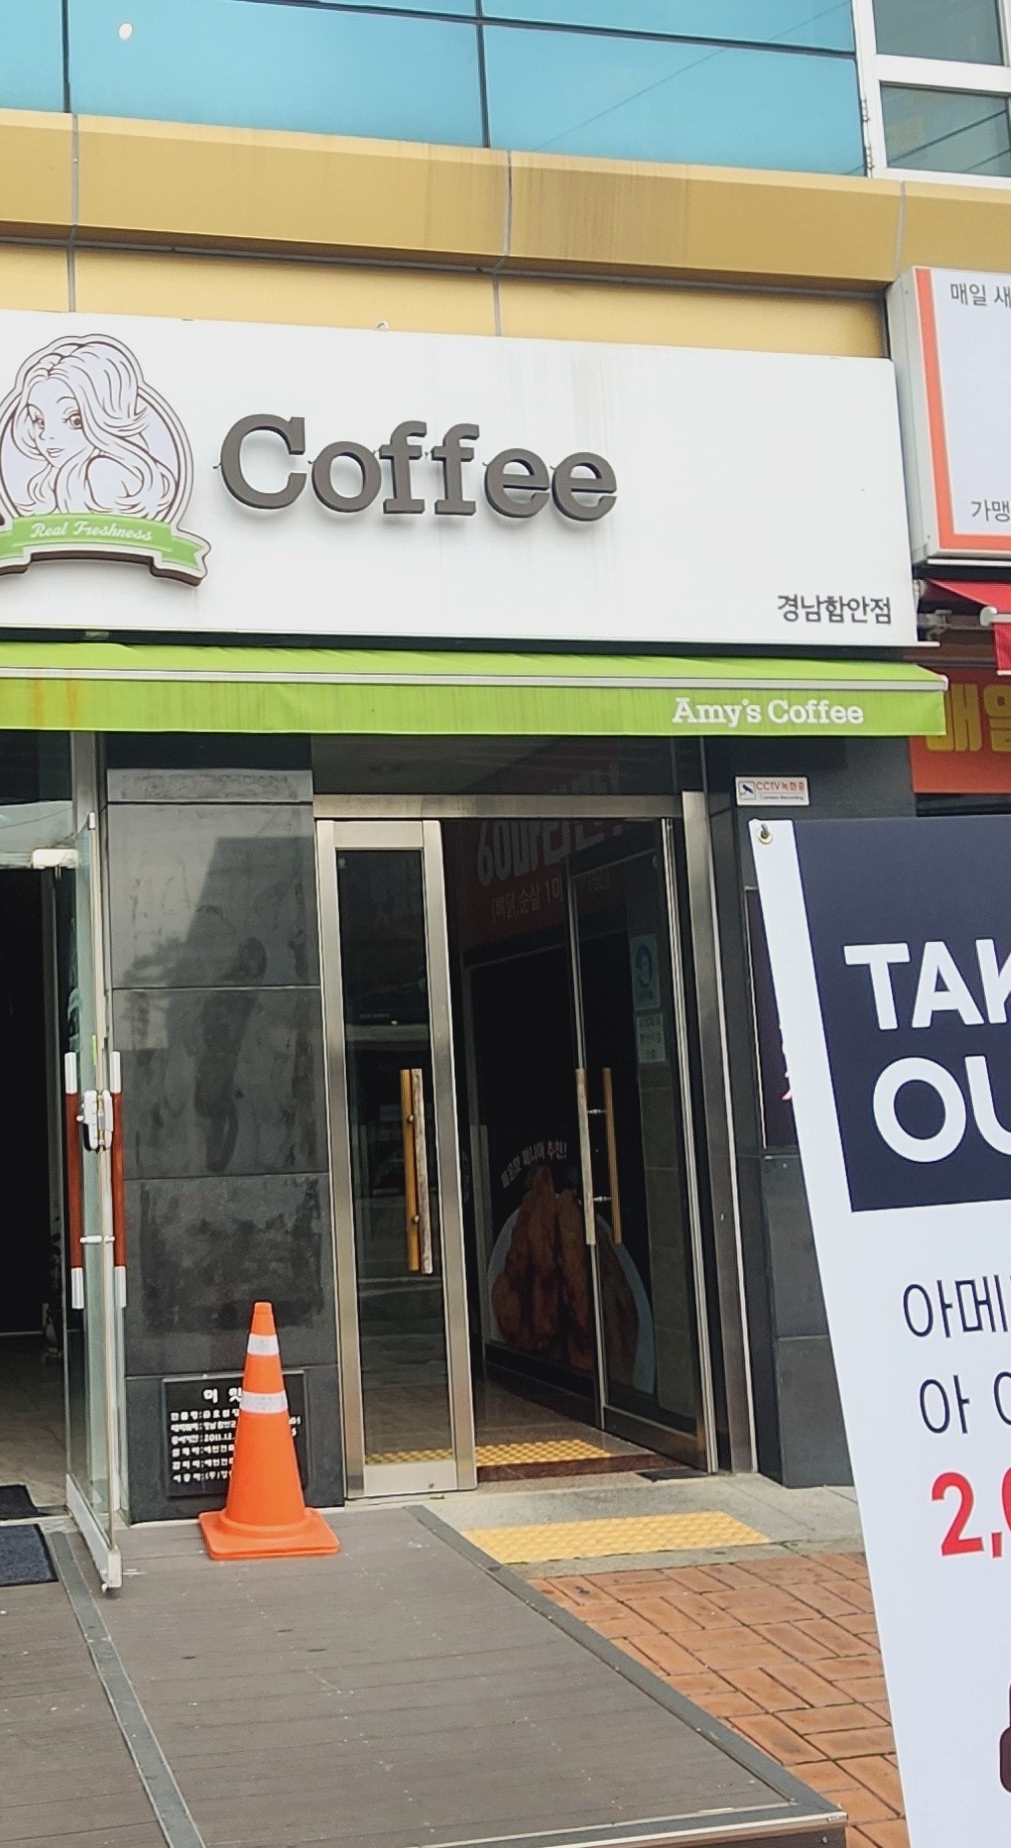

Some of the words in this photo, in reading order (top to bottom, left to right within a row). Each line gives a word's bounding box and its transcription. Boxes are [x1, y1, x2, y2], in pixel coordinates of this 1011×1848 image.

[950, 283, 988, 307] 매일
[218, 412, 617, 523] Coffee
[29, 521, 69, 538] Real
[72, 520, 153, 541] Freshness
[777, 594, 892, 625] 경남함안점
[671, 697, 762, 728] Amy's
[767, 699, 864, 725] Coffee
